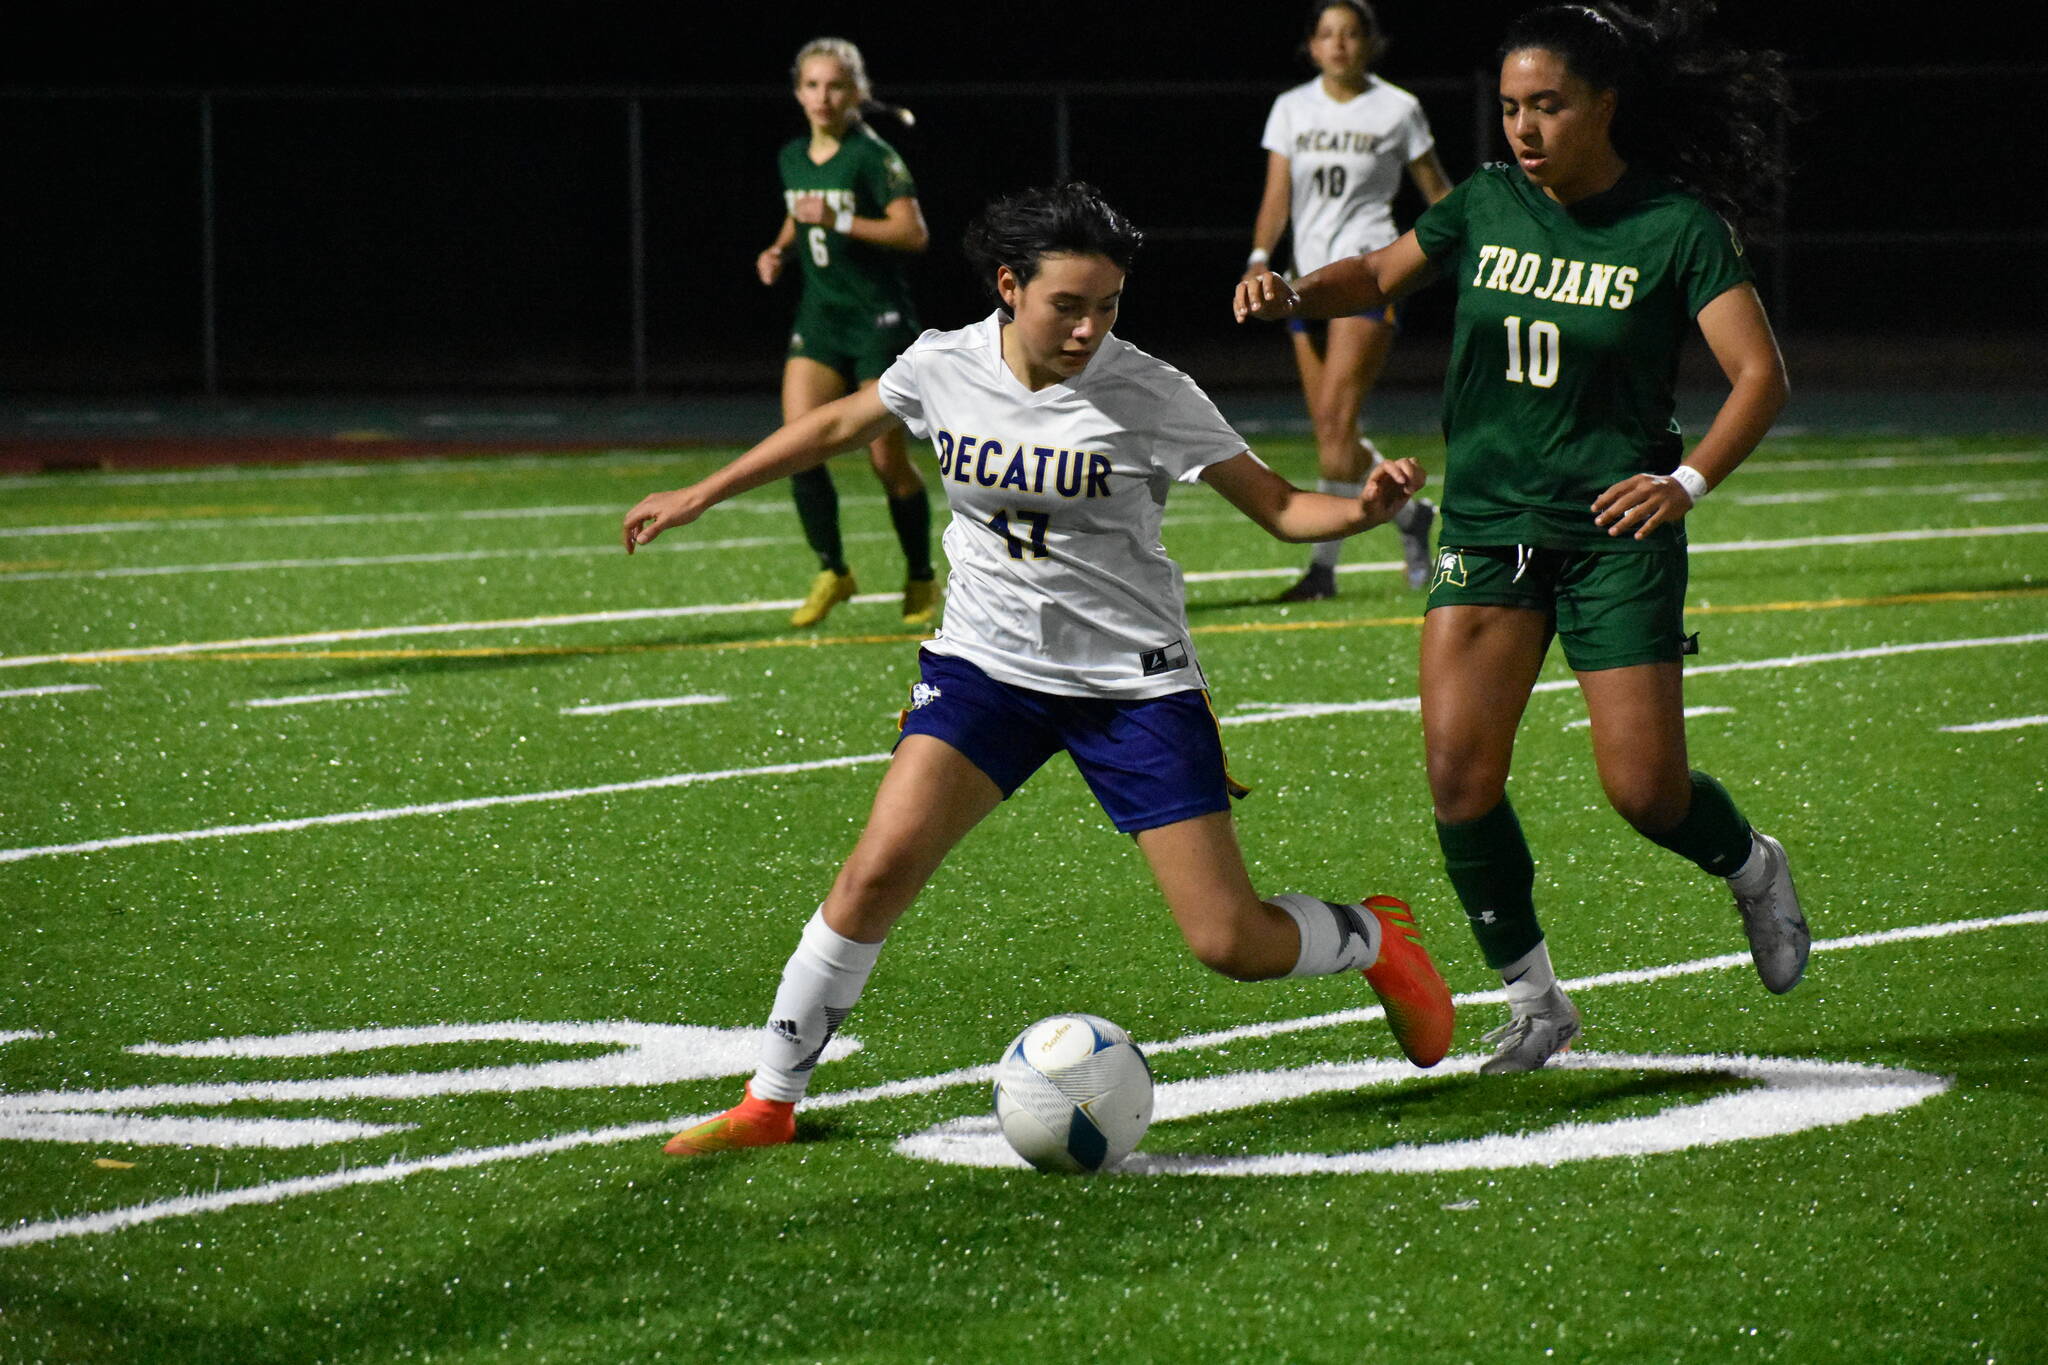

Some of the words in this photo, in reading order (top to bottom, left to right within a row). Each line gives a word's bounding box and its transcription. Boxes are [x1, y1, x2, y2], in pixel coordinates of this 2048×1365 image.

[808, 227, 829, 267] 6
[1472, 245, 1639, 310] TROJANS
[1504, 315, 1560, 388] 10
[938, 427, 1113, 499] DECATUR
